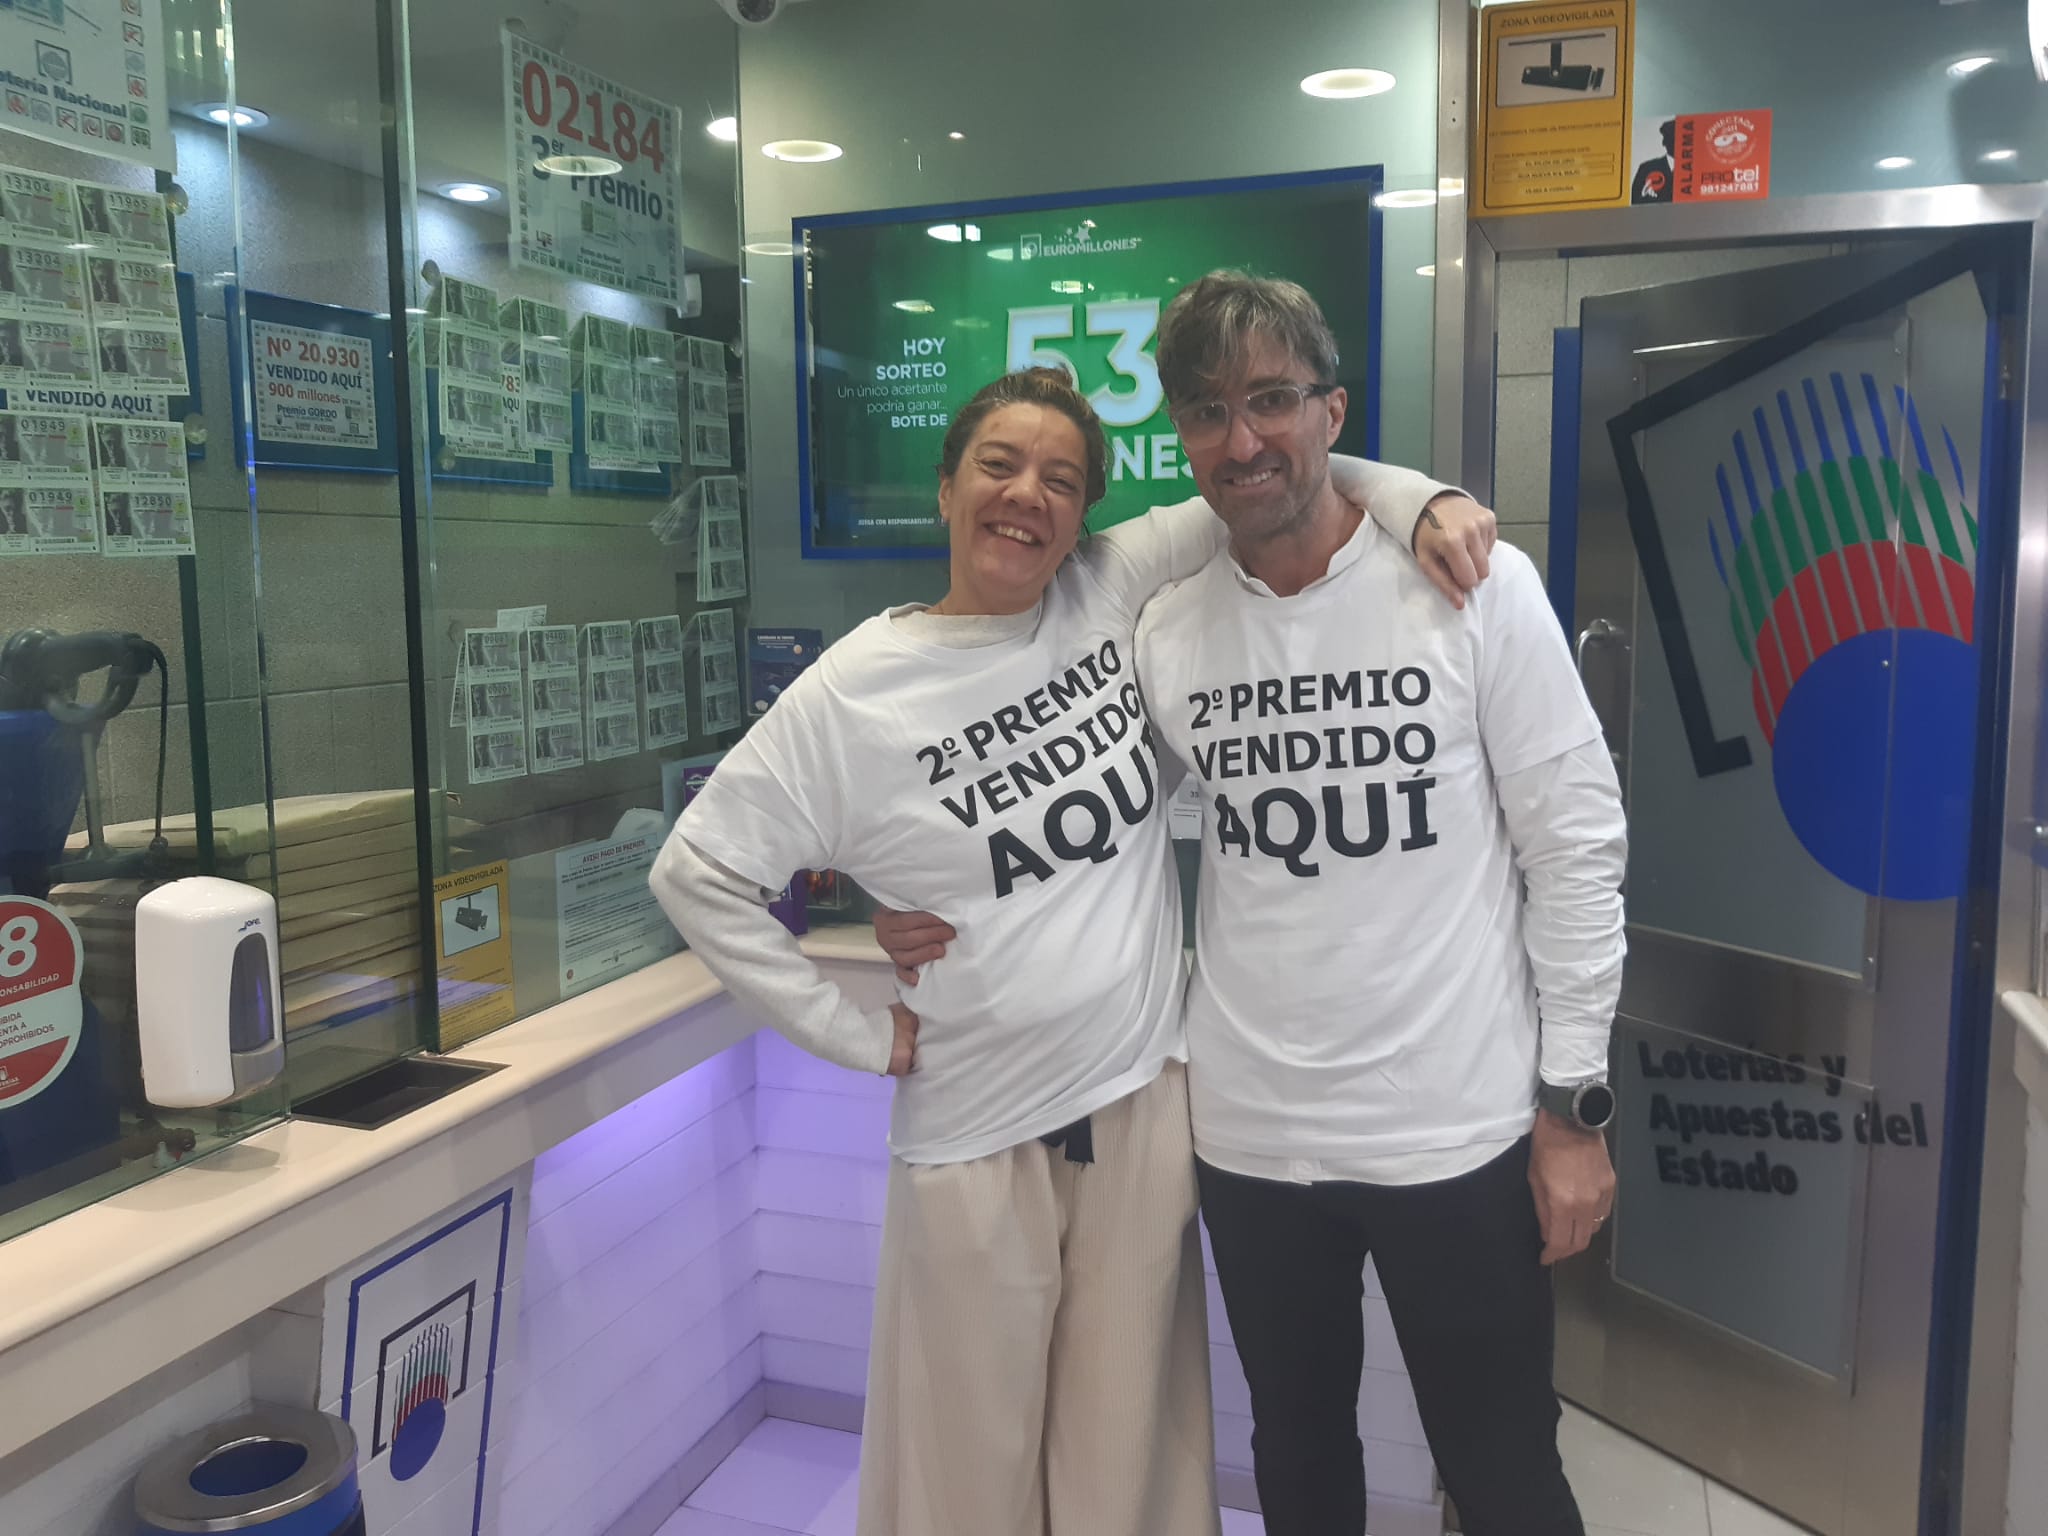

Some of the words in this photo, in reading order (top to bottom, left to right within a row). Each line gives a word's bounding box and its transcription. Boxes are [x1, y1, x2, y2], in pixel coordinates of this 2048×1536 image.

[1501, 16, 1530, 28] ZONA
[1533, 8, 1615, 25] VIDEOVIGILADA
[54, 85, 127, 118] Nacional
[523, 61, 664, 174] 02184
[1681, 120, 1694, 195] ALARMA
[570, 154, 663, 220] Premio
[1043, 240, 1137, 256] EUROMILLONES
[267, 336, 291, 357] Nº
[298, 341, 360, 369] 20.930
[903, 337, 946, 357] HOY
[1006, 298, 1166, 427] 53
[266, 364, 328, 385] VENDIDO
[331, 372, 362, 390] AQUÍ
[876, 363, 947, 381] SORTEO
[26, 389, 107, 409] VENDIDO
[111, 394, 153, 414] AQUÍ
[269, 382, 294, 398] 900
[297, 388, 341, 404] millones
[838, 385, 855, 399] Un
[857, 382, 889, 398] único
[891, 382, 948, 397] acertante
[277, 404, 306, 416] Premio
[308, 408, 338, 419] GORDO
[867, 399, 905, 416] podría
[891, 414, 926, 428] BOTE
[930, 414, 948, 426] DE
[1112, 433, 1197, 481] NE
[915, 737, 962, 785] 2º
[963, 640, 1121, 761] PREMIO
[1188, 689, 1223, 730] 2º
[1230, 666, 1431, 722] PREMIO
[939, 682, 1141, 828] VENDIDO
[1191, 722, 1436, 781] VENDIDO
[1214, 769, 1438, 878] AQUÍ
[600, 848, 615, 859] PAGO
[432, 881, 453, 892] ZONA
[454, 865, 504, 887] VIDEOVIGILADA
[21, 1021, 27, 1029] A
[1638, 1041, 1808, 1084] Loterías
[1820, 1055, 1846, 1097] y
[1649, 1094, 1843, 1143] Apuestas
[1853, 1101, 1929, 1147] del
[1655, 1144, 1799, 1195] Estado
